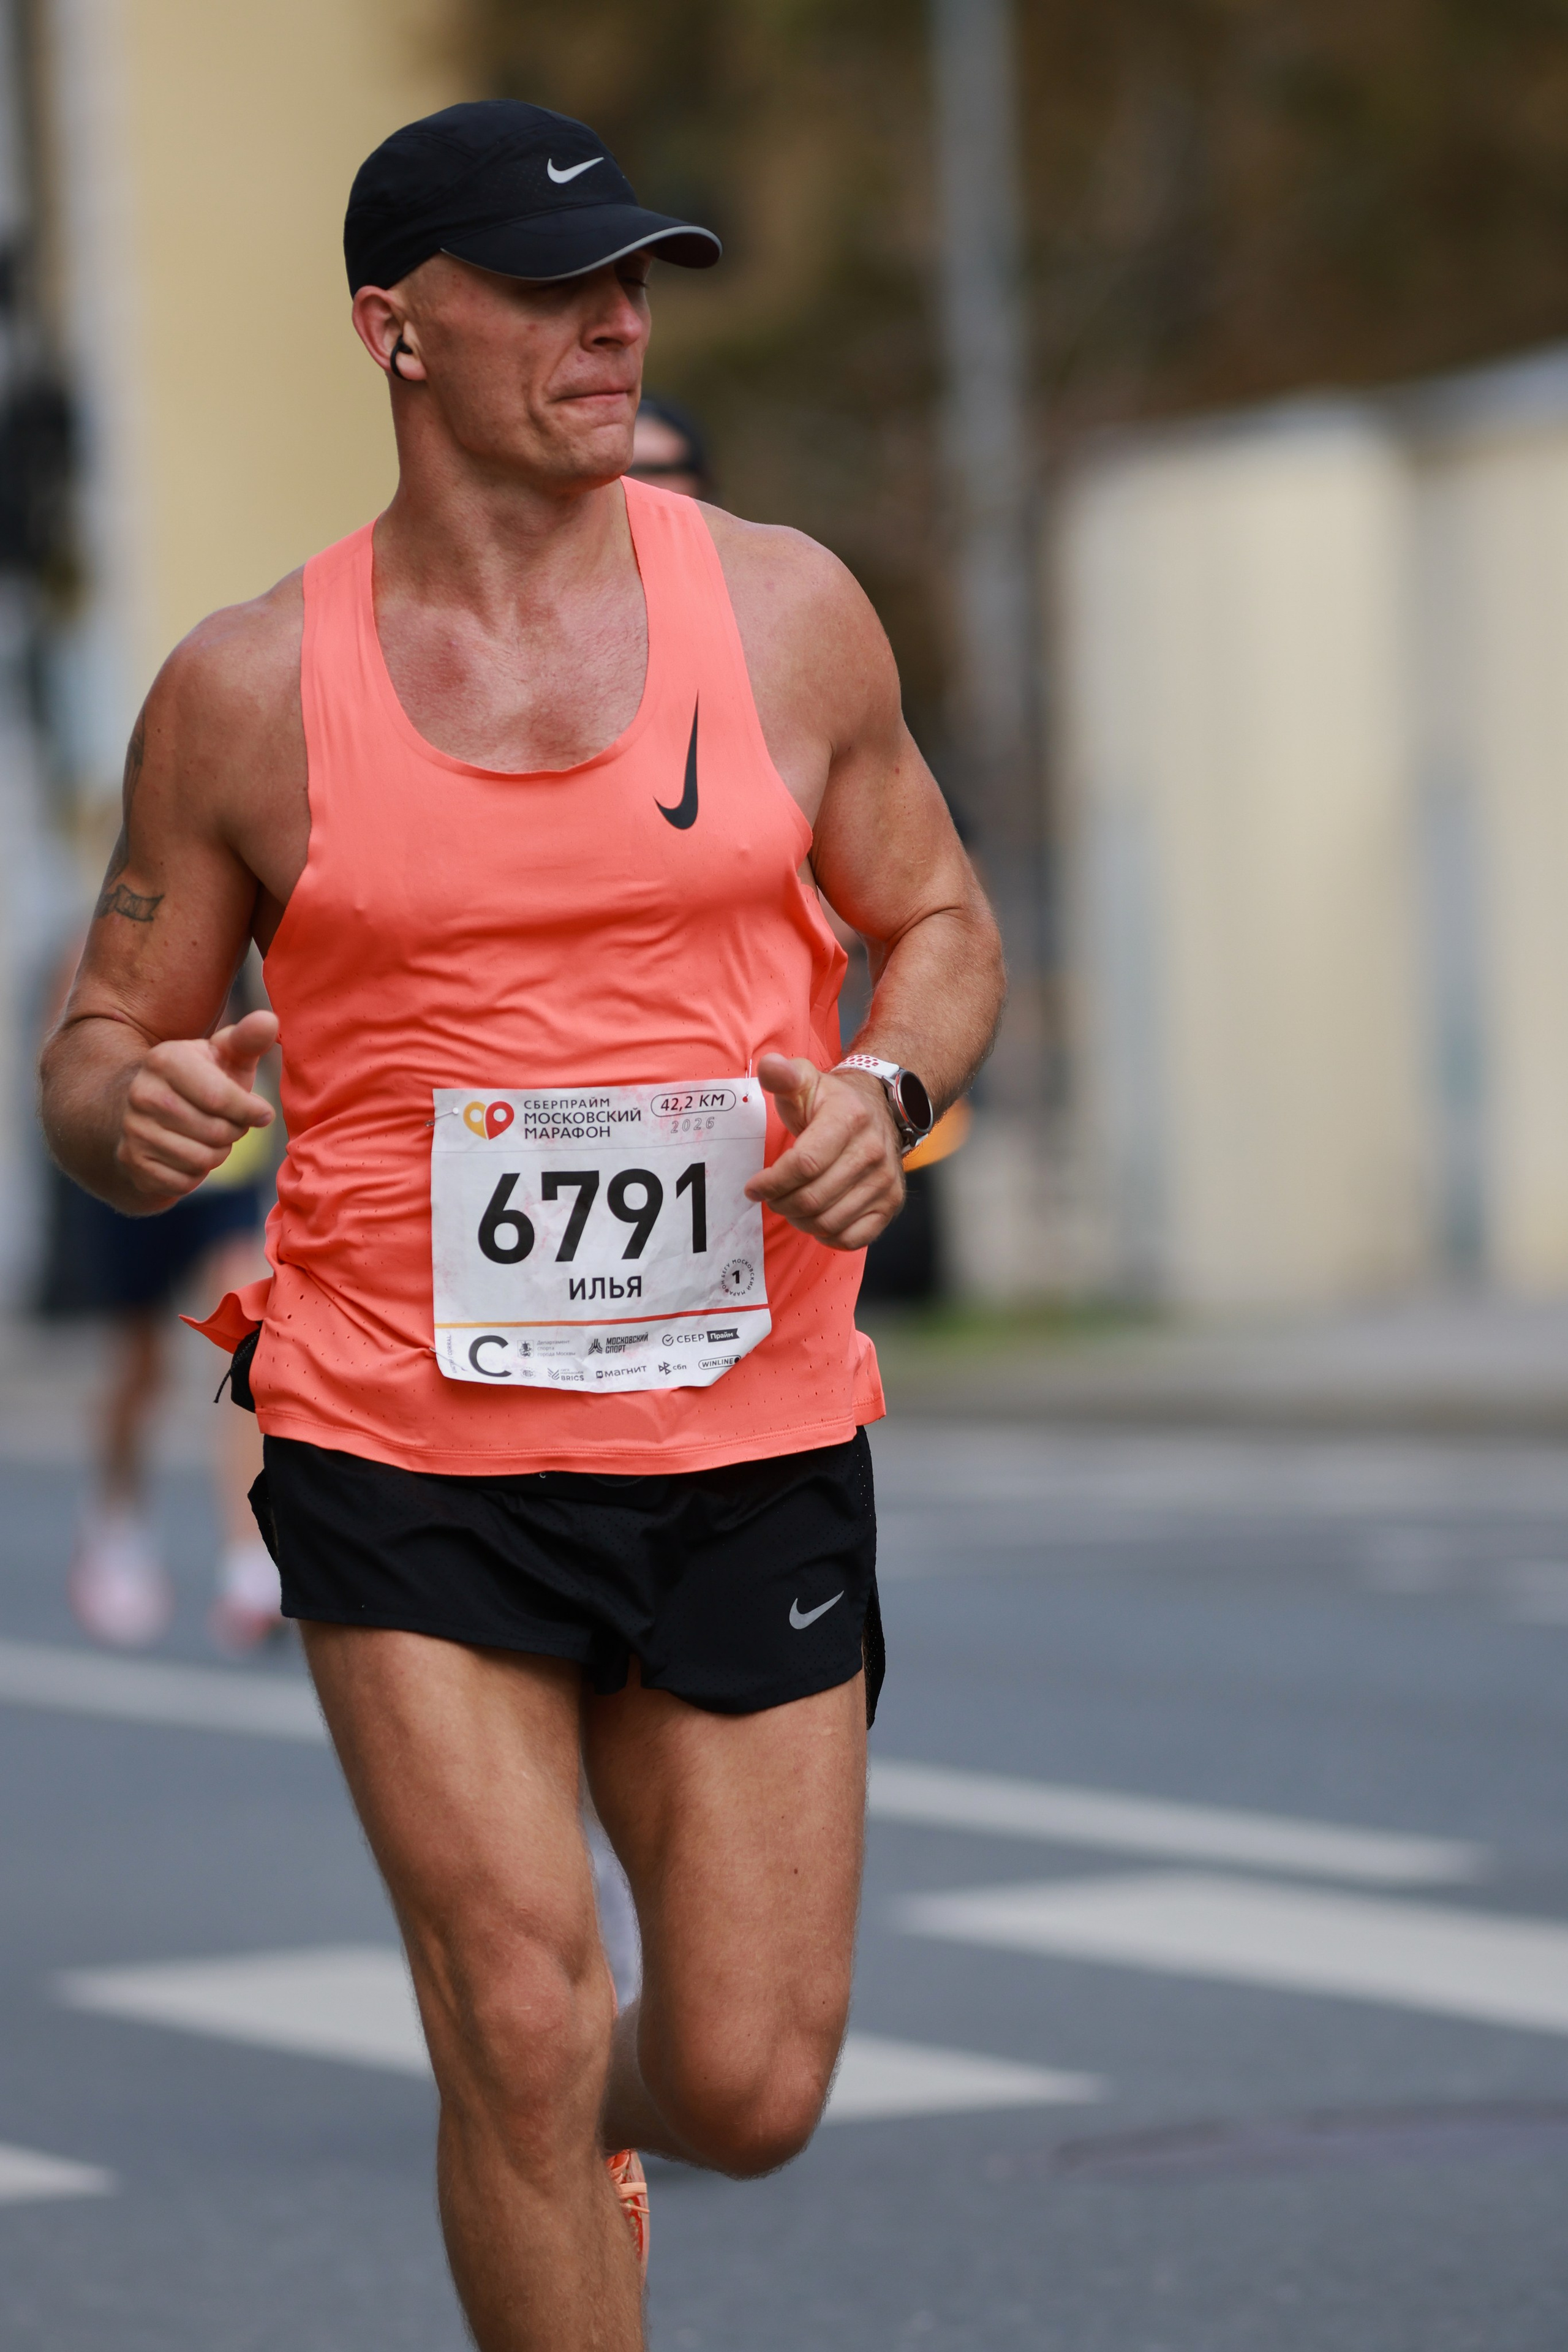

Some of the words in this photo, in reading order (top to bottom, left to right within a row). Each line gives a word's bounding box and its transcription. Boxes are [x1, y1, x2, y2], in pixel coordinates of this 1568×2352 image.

[524, 1096, 610, 1109] СБЕРПРАЙМ
[660, 1096, 693, 1112] 42,2
[524, 1107, 641, 1125] МОСКОВСКИЙ
[524, 1126, 611, 1139] МАРАФОН
[670, 1117, 715, 1134] 2026
[478, 1161, 707, 1264] 6791
[731, 1270, 740, 1284] 1
[568, 1275, 643, 1300] ИЛЬЯ
[606, 1332, 649, 1346] МОСКОВСКИЙ
[677, 1333, 704, 1343] СБЕР
[710, 1332, 734, 1340] Прайм
[605, 1344, 626, 1354] СПОРТ
[702, 1358, 733, 1368] WINLINE
